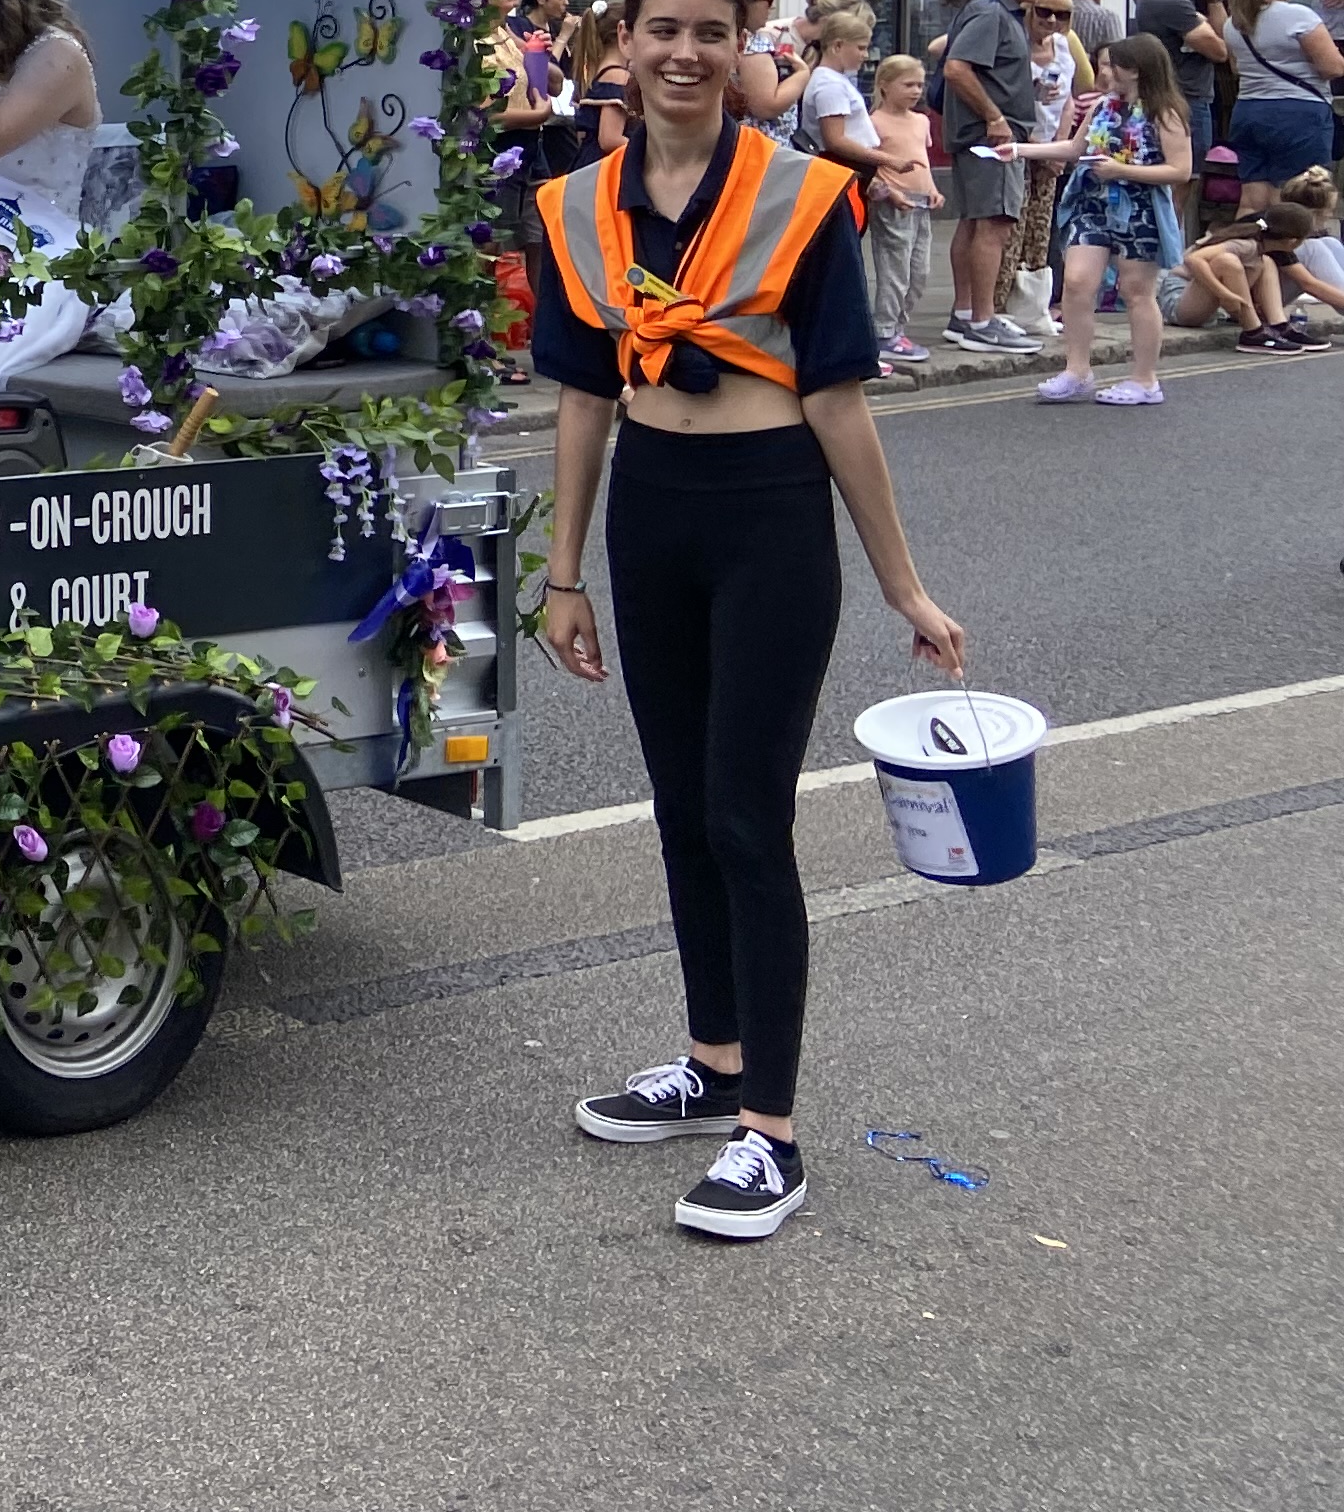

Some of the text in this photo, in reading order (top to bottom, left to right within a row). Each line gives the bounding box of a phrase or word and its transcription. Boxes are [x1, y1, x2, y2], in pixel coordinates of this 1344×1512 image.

[9, 482, 212, 550] -ON-CROUCH
[9, 581, 29, 634] &
[50, 571, 150, 631] COURT
